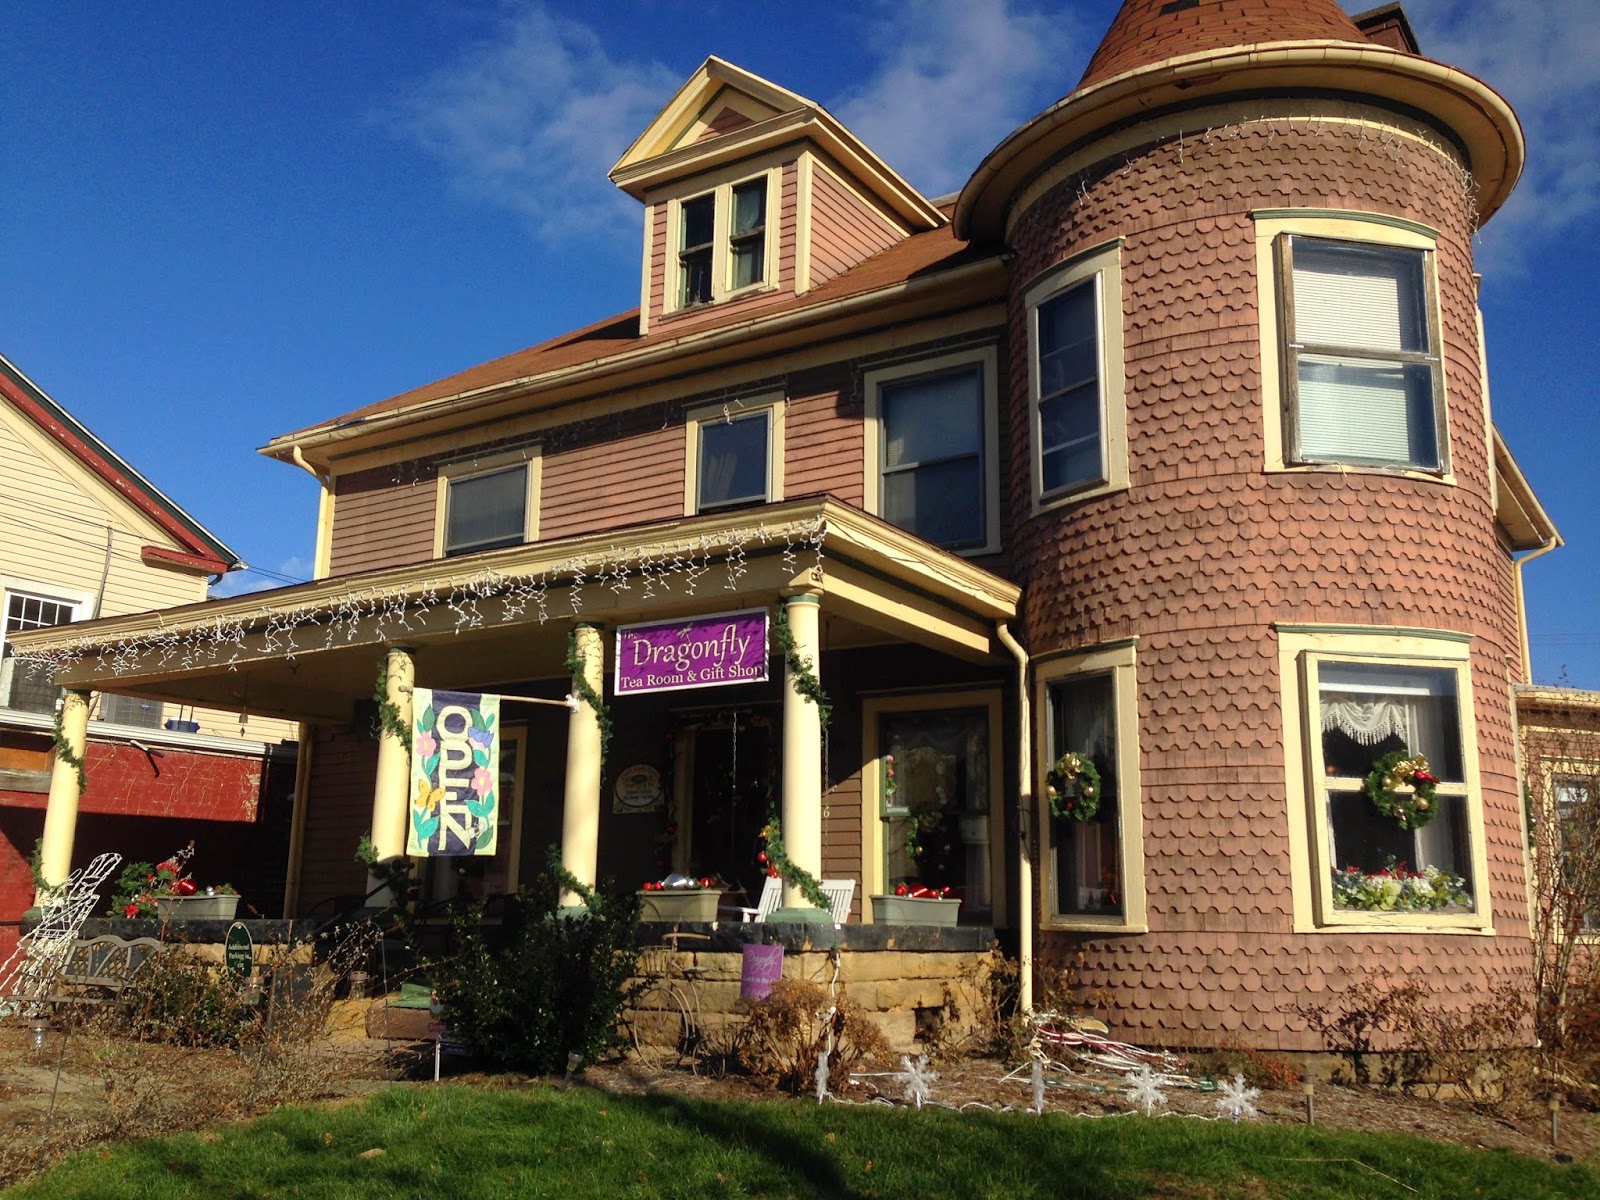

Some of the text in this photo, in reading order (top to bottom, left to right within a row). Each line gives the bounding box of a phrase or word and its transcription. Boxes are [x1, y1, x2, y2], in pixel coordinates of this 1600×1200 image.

[633, 624, 751, 672] Dragonfly
[621, 664, 763, 688] Tea Room & Gift Shop
[436, 705, 474, 851] OPEN
